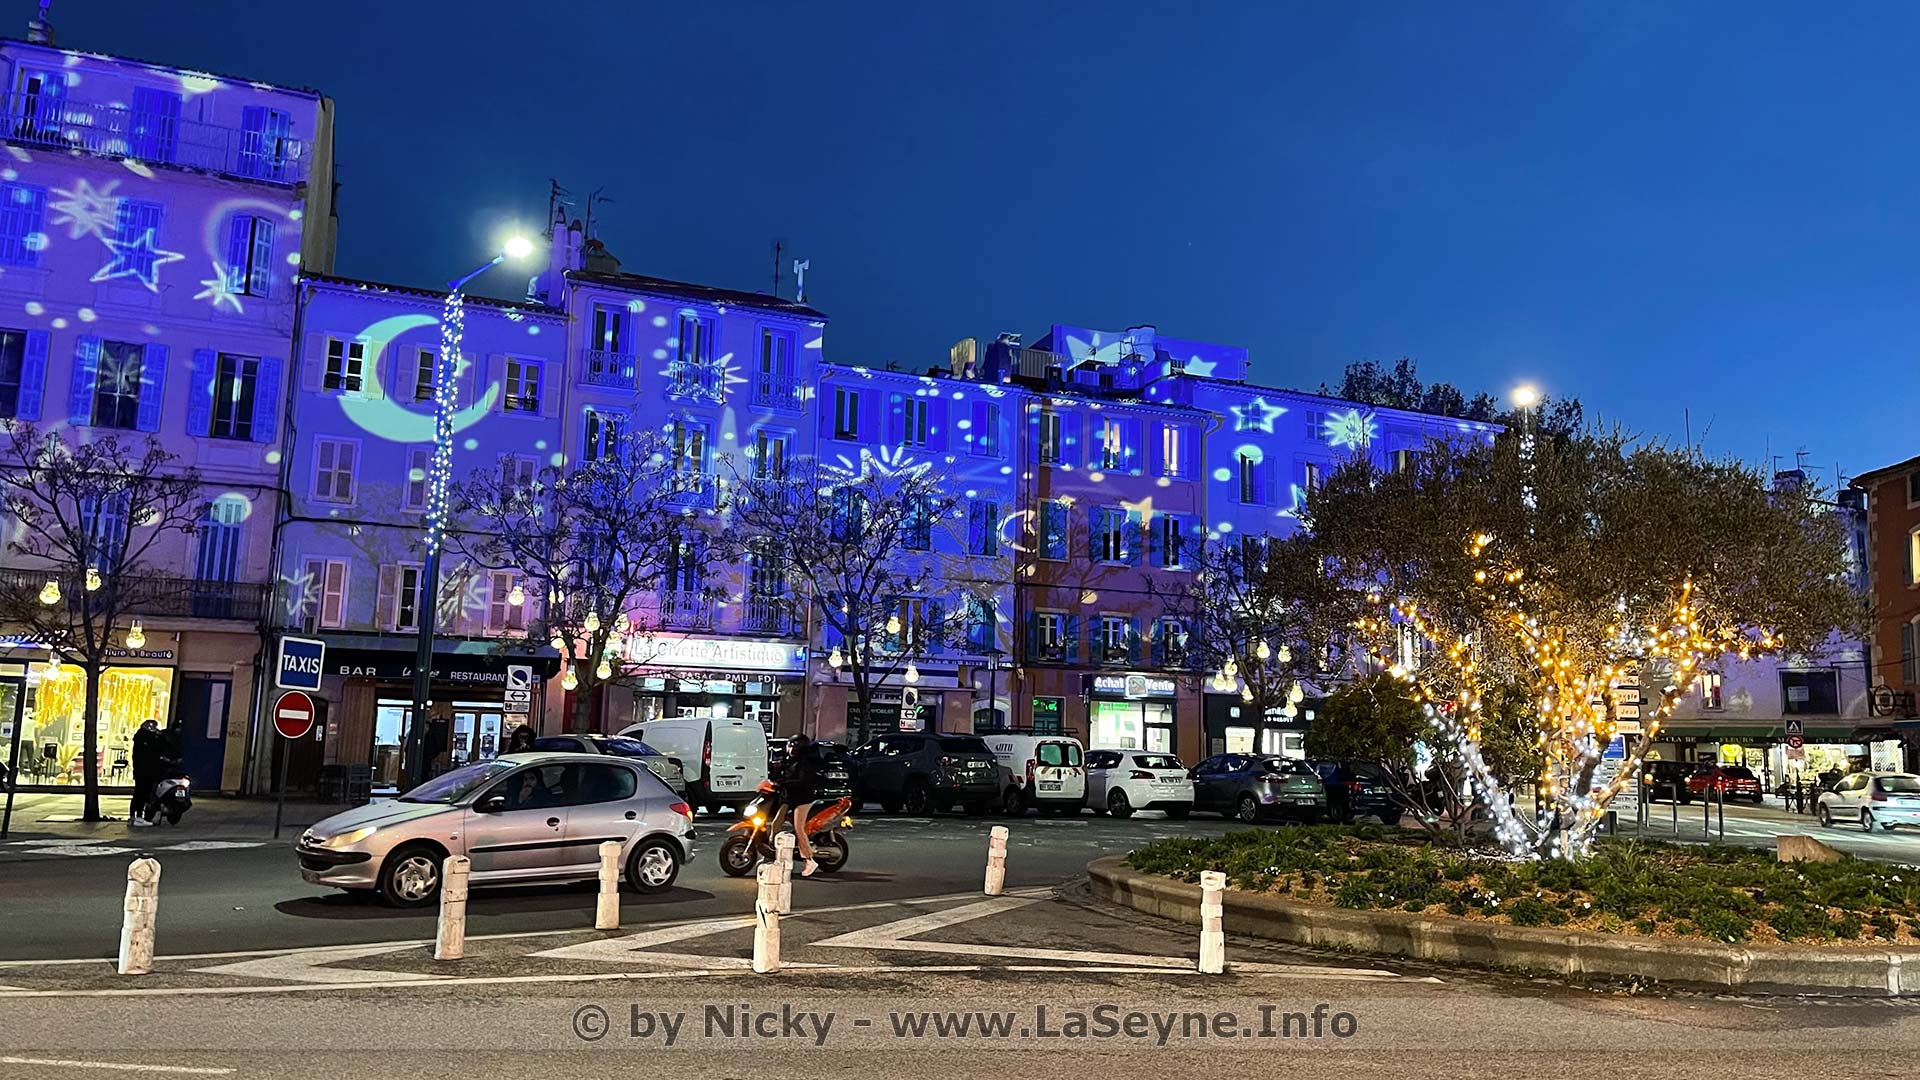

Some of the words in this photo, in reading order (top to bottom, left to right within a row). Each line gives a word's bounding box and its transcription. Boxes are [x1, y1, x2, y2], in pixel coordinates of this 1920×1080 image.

[657, 641, 709, 658] Civette
[712, 644, 784, 663] Artistique
[283, 654, 320, 674] TAXIS
[340, 665, 377, 676] BAR
[680, 671, 715, 681] TABAC
[725, 674, 748, 683] PMU
[757, 675, 777, 683] FDJ
[1094, 676, 1125, 688] Achat
[1145, 679, 1175, 691] Vente
